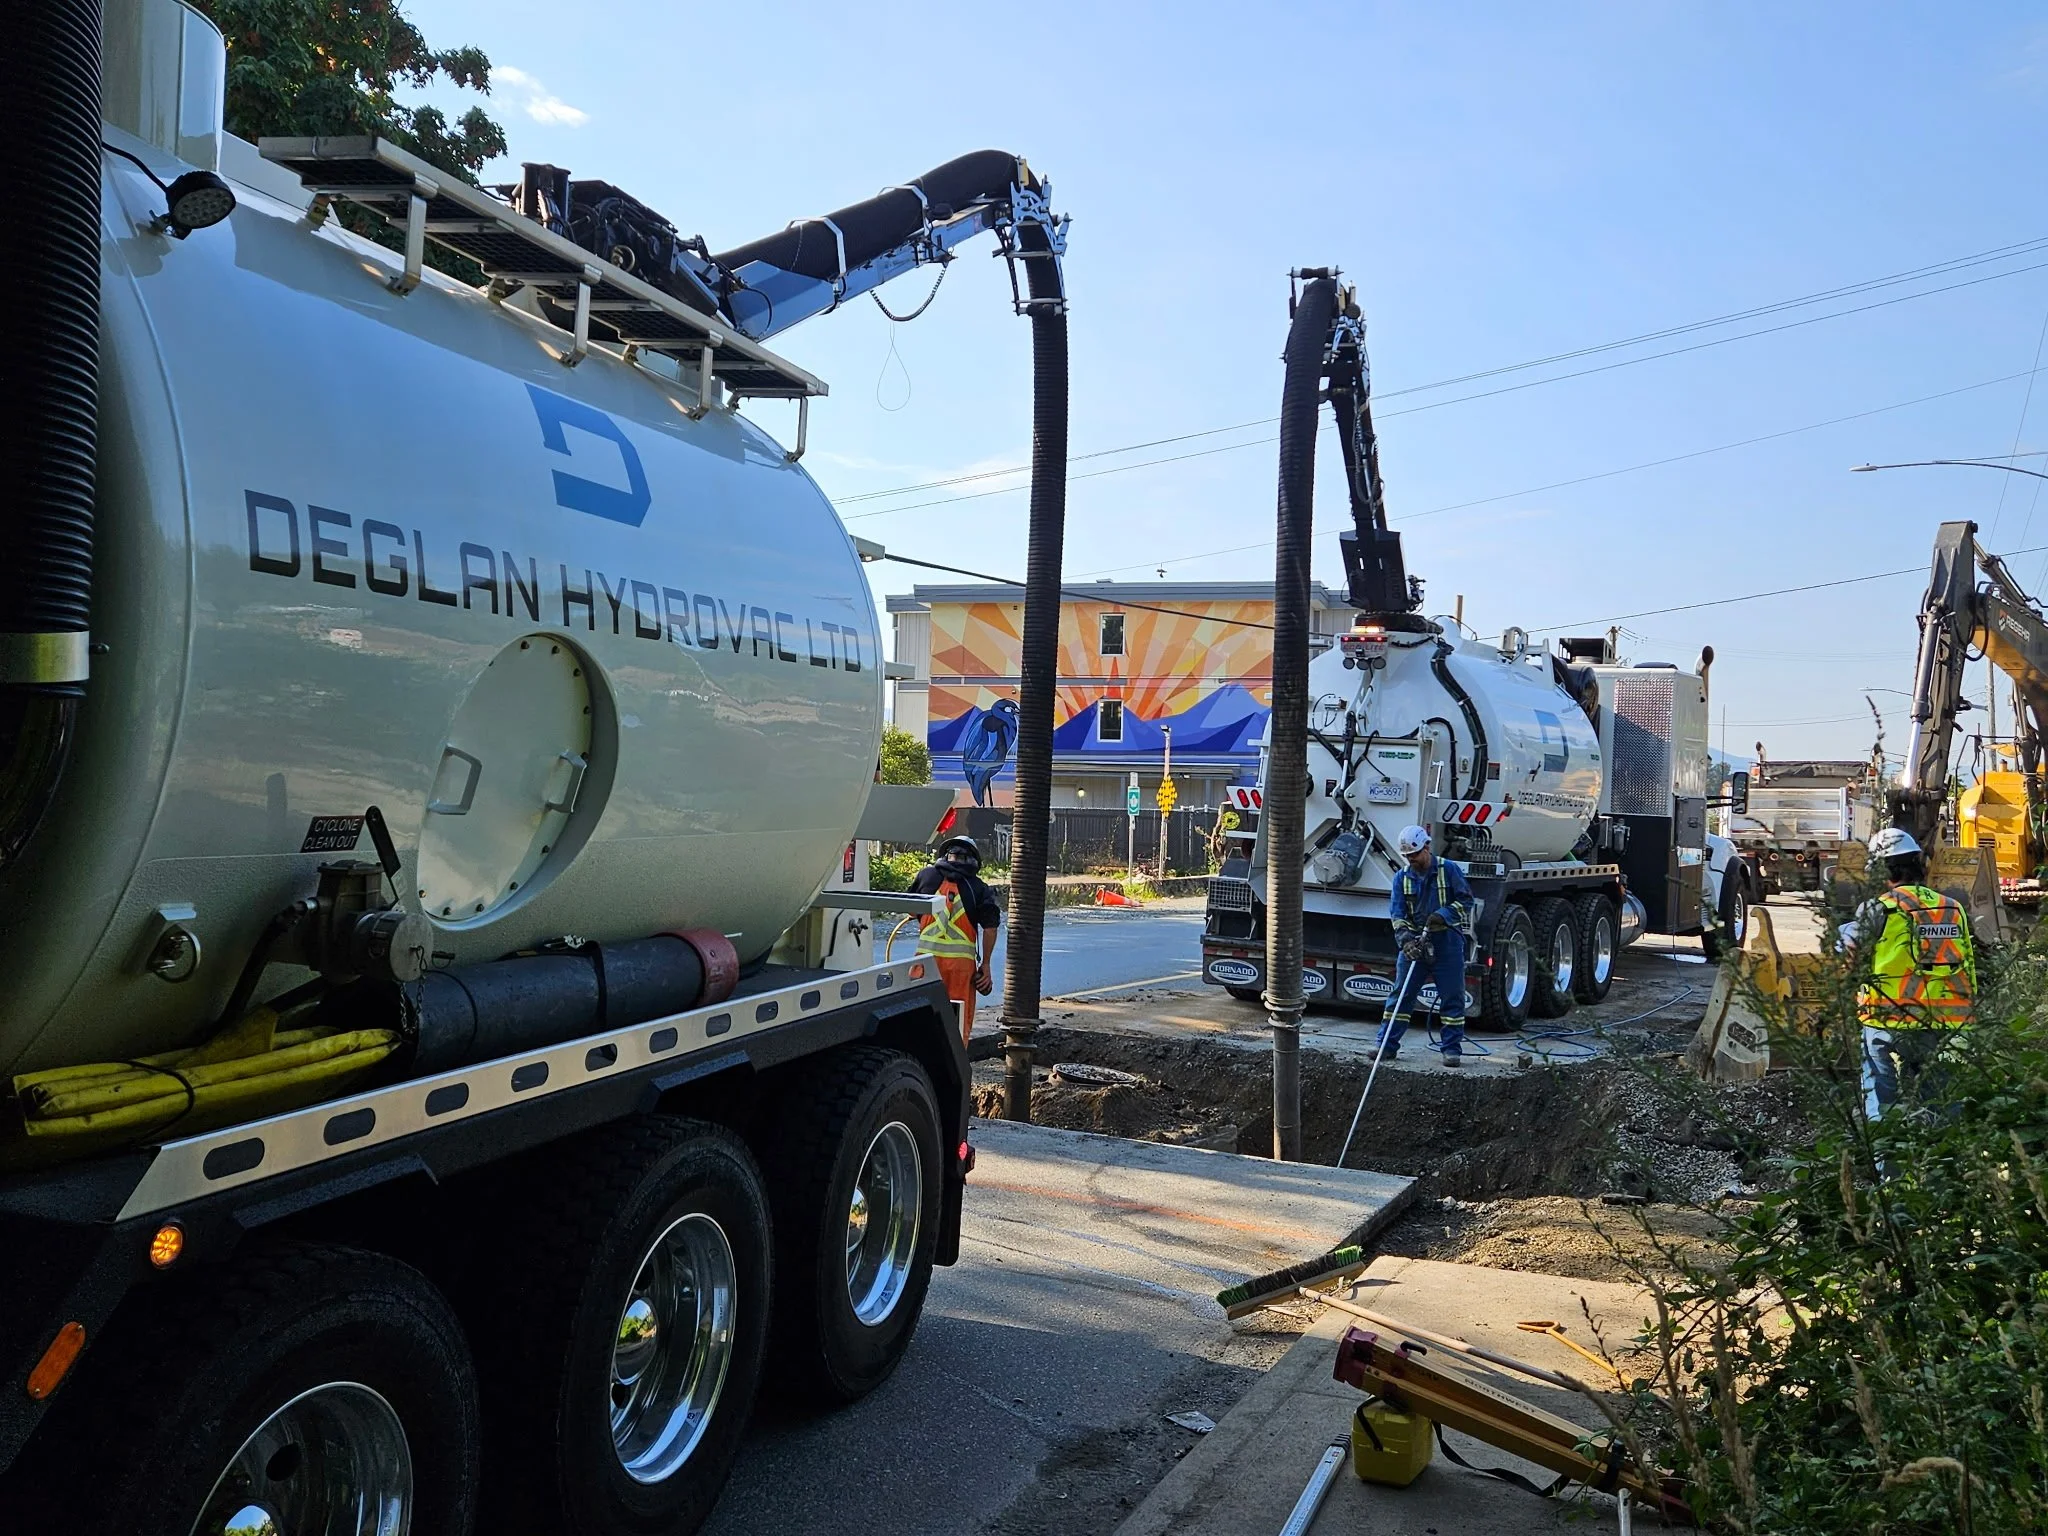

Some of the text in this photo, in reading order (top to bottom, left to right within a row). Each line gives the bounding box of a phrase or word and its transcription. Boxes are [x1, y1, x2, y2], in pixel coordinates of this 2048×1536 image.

[244, 489, 862, 673] DEGLAN HYDROVAC LTD
[314, 818, 360, 832] CYCLONE
[304, 835, 358, 850] CLEAN OUT
[1214, 964, 1254, 976] TORNADO
[1349, 980, 1394, 993] TORNADO
[1464, 1378, 1535, 1413] NORTHWEST
